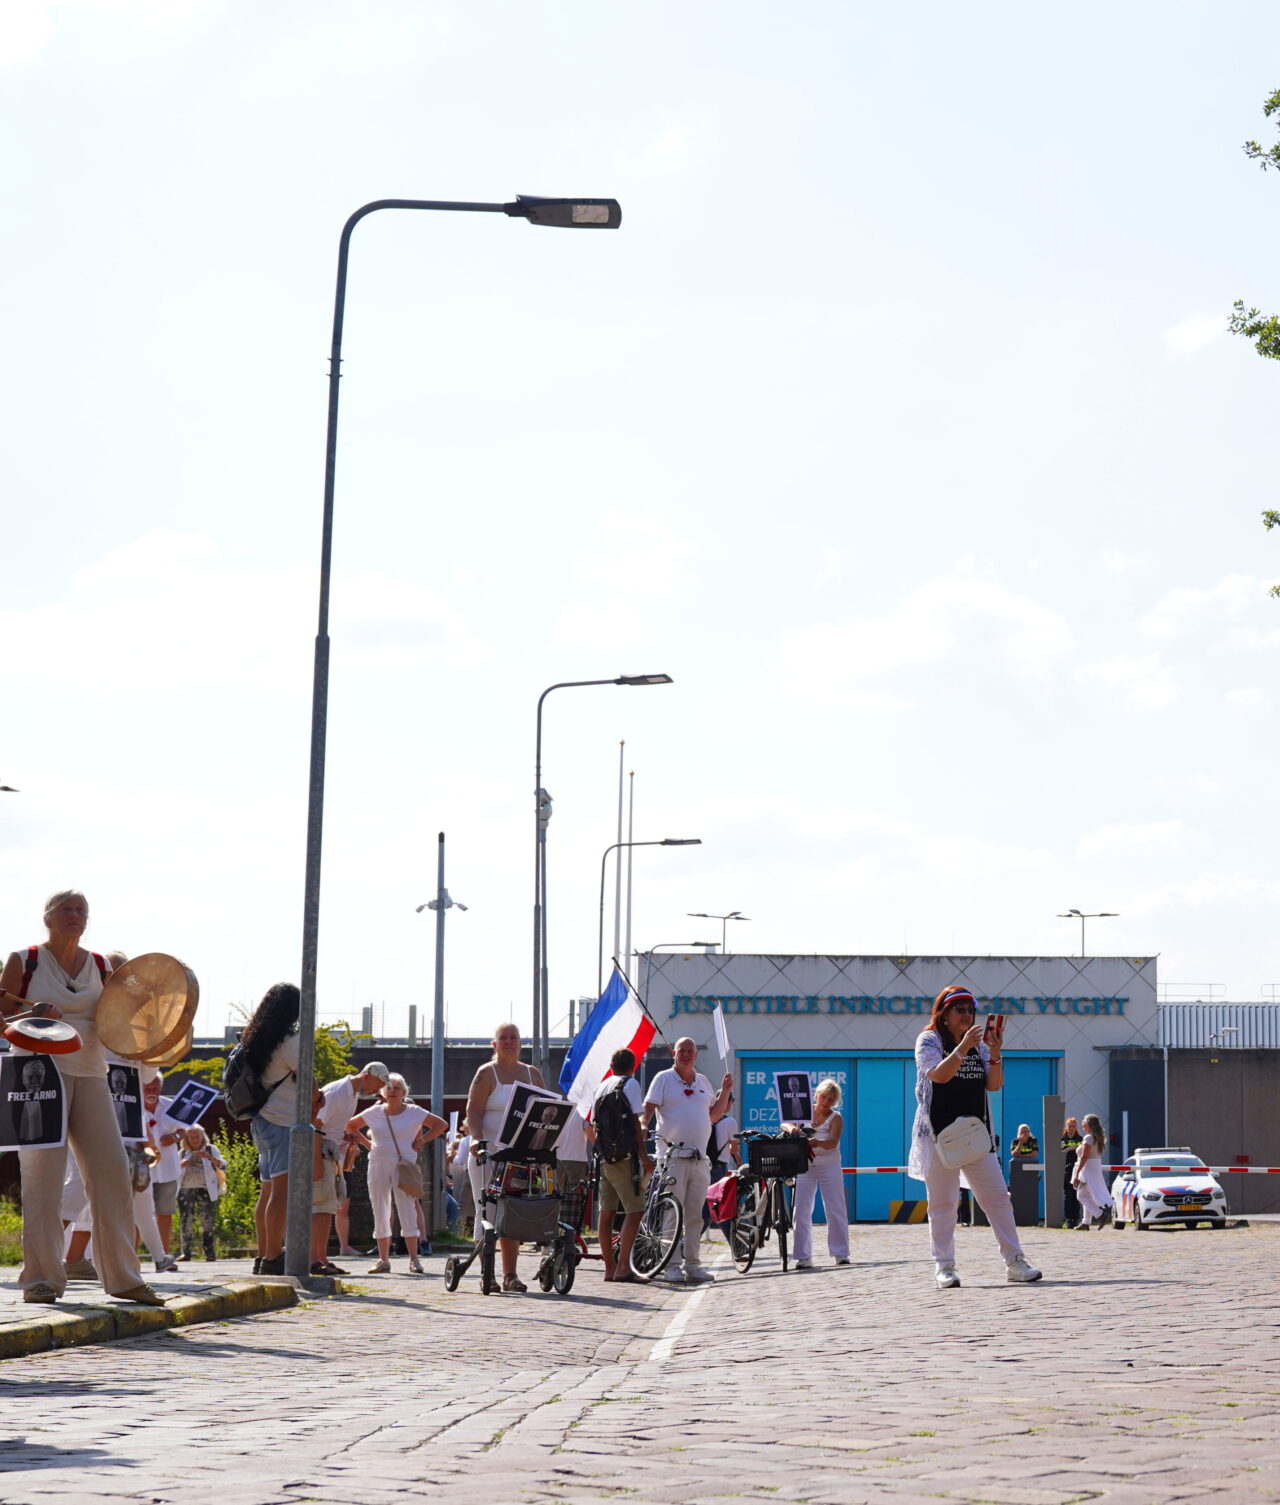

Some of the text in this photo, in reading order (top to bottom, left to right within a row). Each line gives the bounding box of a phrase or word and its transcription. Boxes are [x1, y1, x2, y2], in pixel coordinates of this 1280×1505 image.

[668, 995, 820, 1019] JUSTITIELE
[1034, 996, 1130, 1016] VUGHT
[746, 1071, 766, 1085] ER
[7, 1089, 57, 1102] FREE ARNO
[120, 1094, 137, 1104] ARNO
[513, 1110, 525, 1119] FRE
[749, 1108, 778, 1121] DEZ
[528, 1121, 543, 1129] FREE
